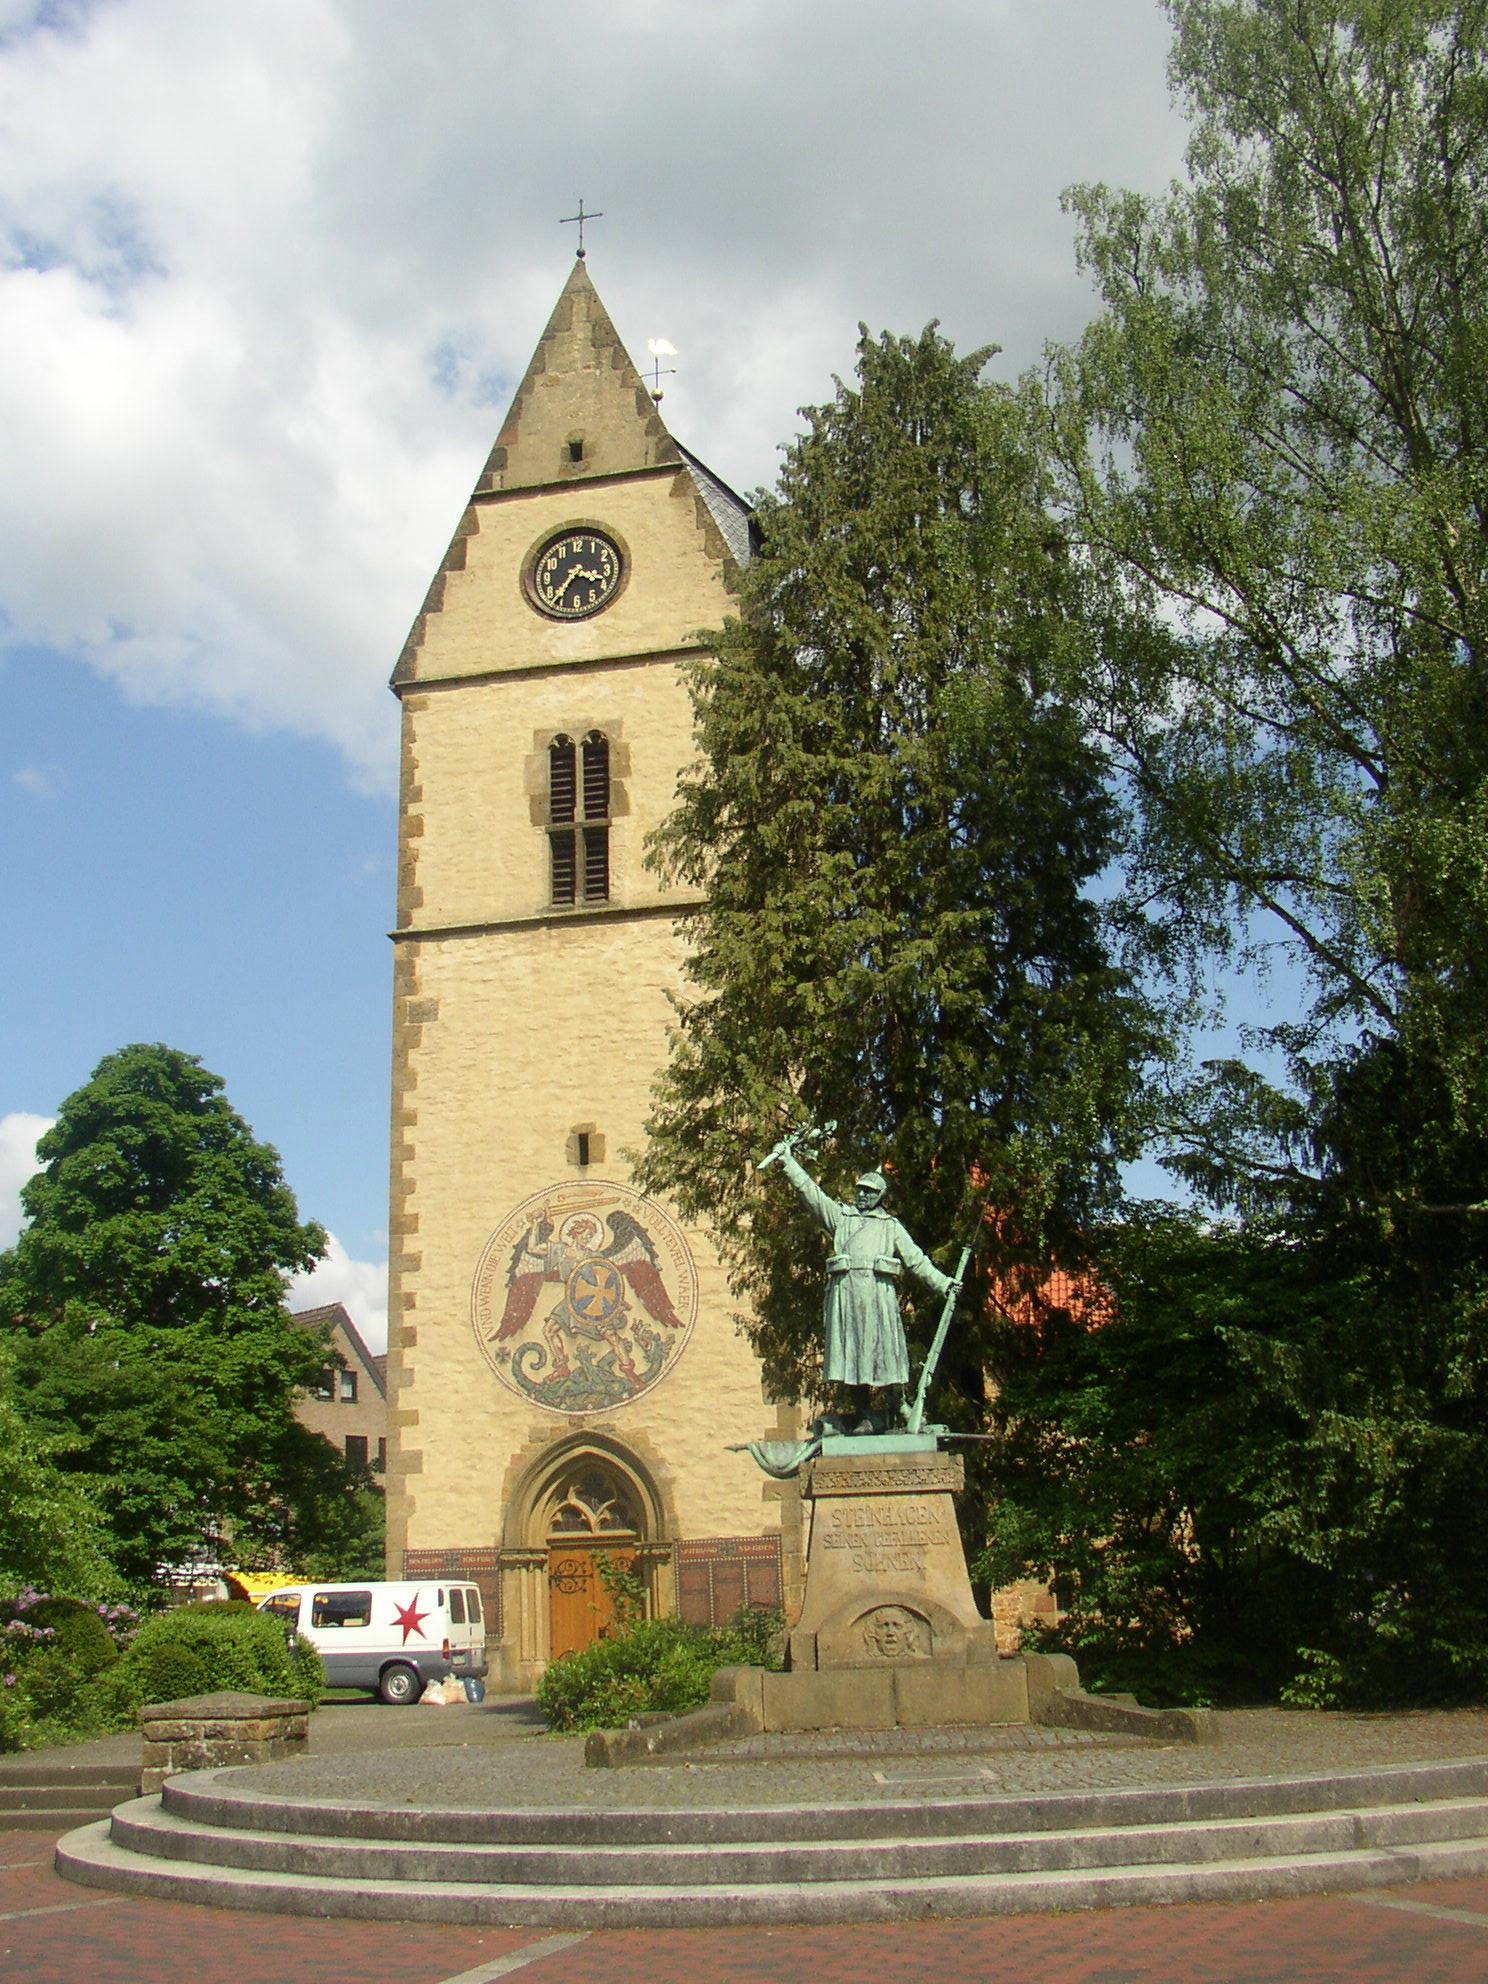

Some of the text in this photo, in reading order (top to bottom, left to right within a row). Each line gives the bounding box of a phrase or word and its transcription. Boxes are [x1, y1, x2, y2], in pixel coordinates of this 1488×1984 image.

[559, 546, 566, 559] 11
[573, 540, 583, 553] 12
[591, 541, 596, 553] 1
[601, 550, 608, 562] 2
[547, 558, 557, 571] 10
[604, 564, 610, 577] 3
[544, 573, 550, 585] 9
[601, 579, 607, 591] 4
[547, 586, 553, 598] 8
[589, 590, 595, 602] 5
[574, 595, 580, 608] 6
[493, 1224, 518, 1252] WELT
[832, 1506, 945, 1527] STEINHAGEN
[823, 1532, 868, 1549] SEINEN
